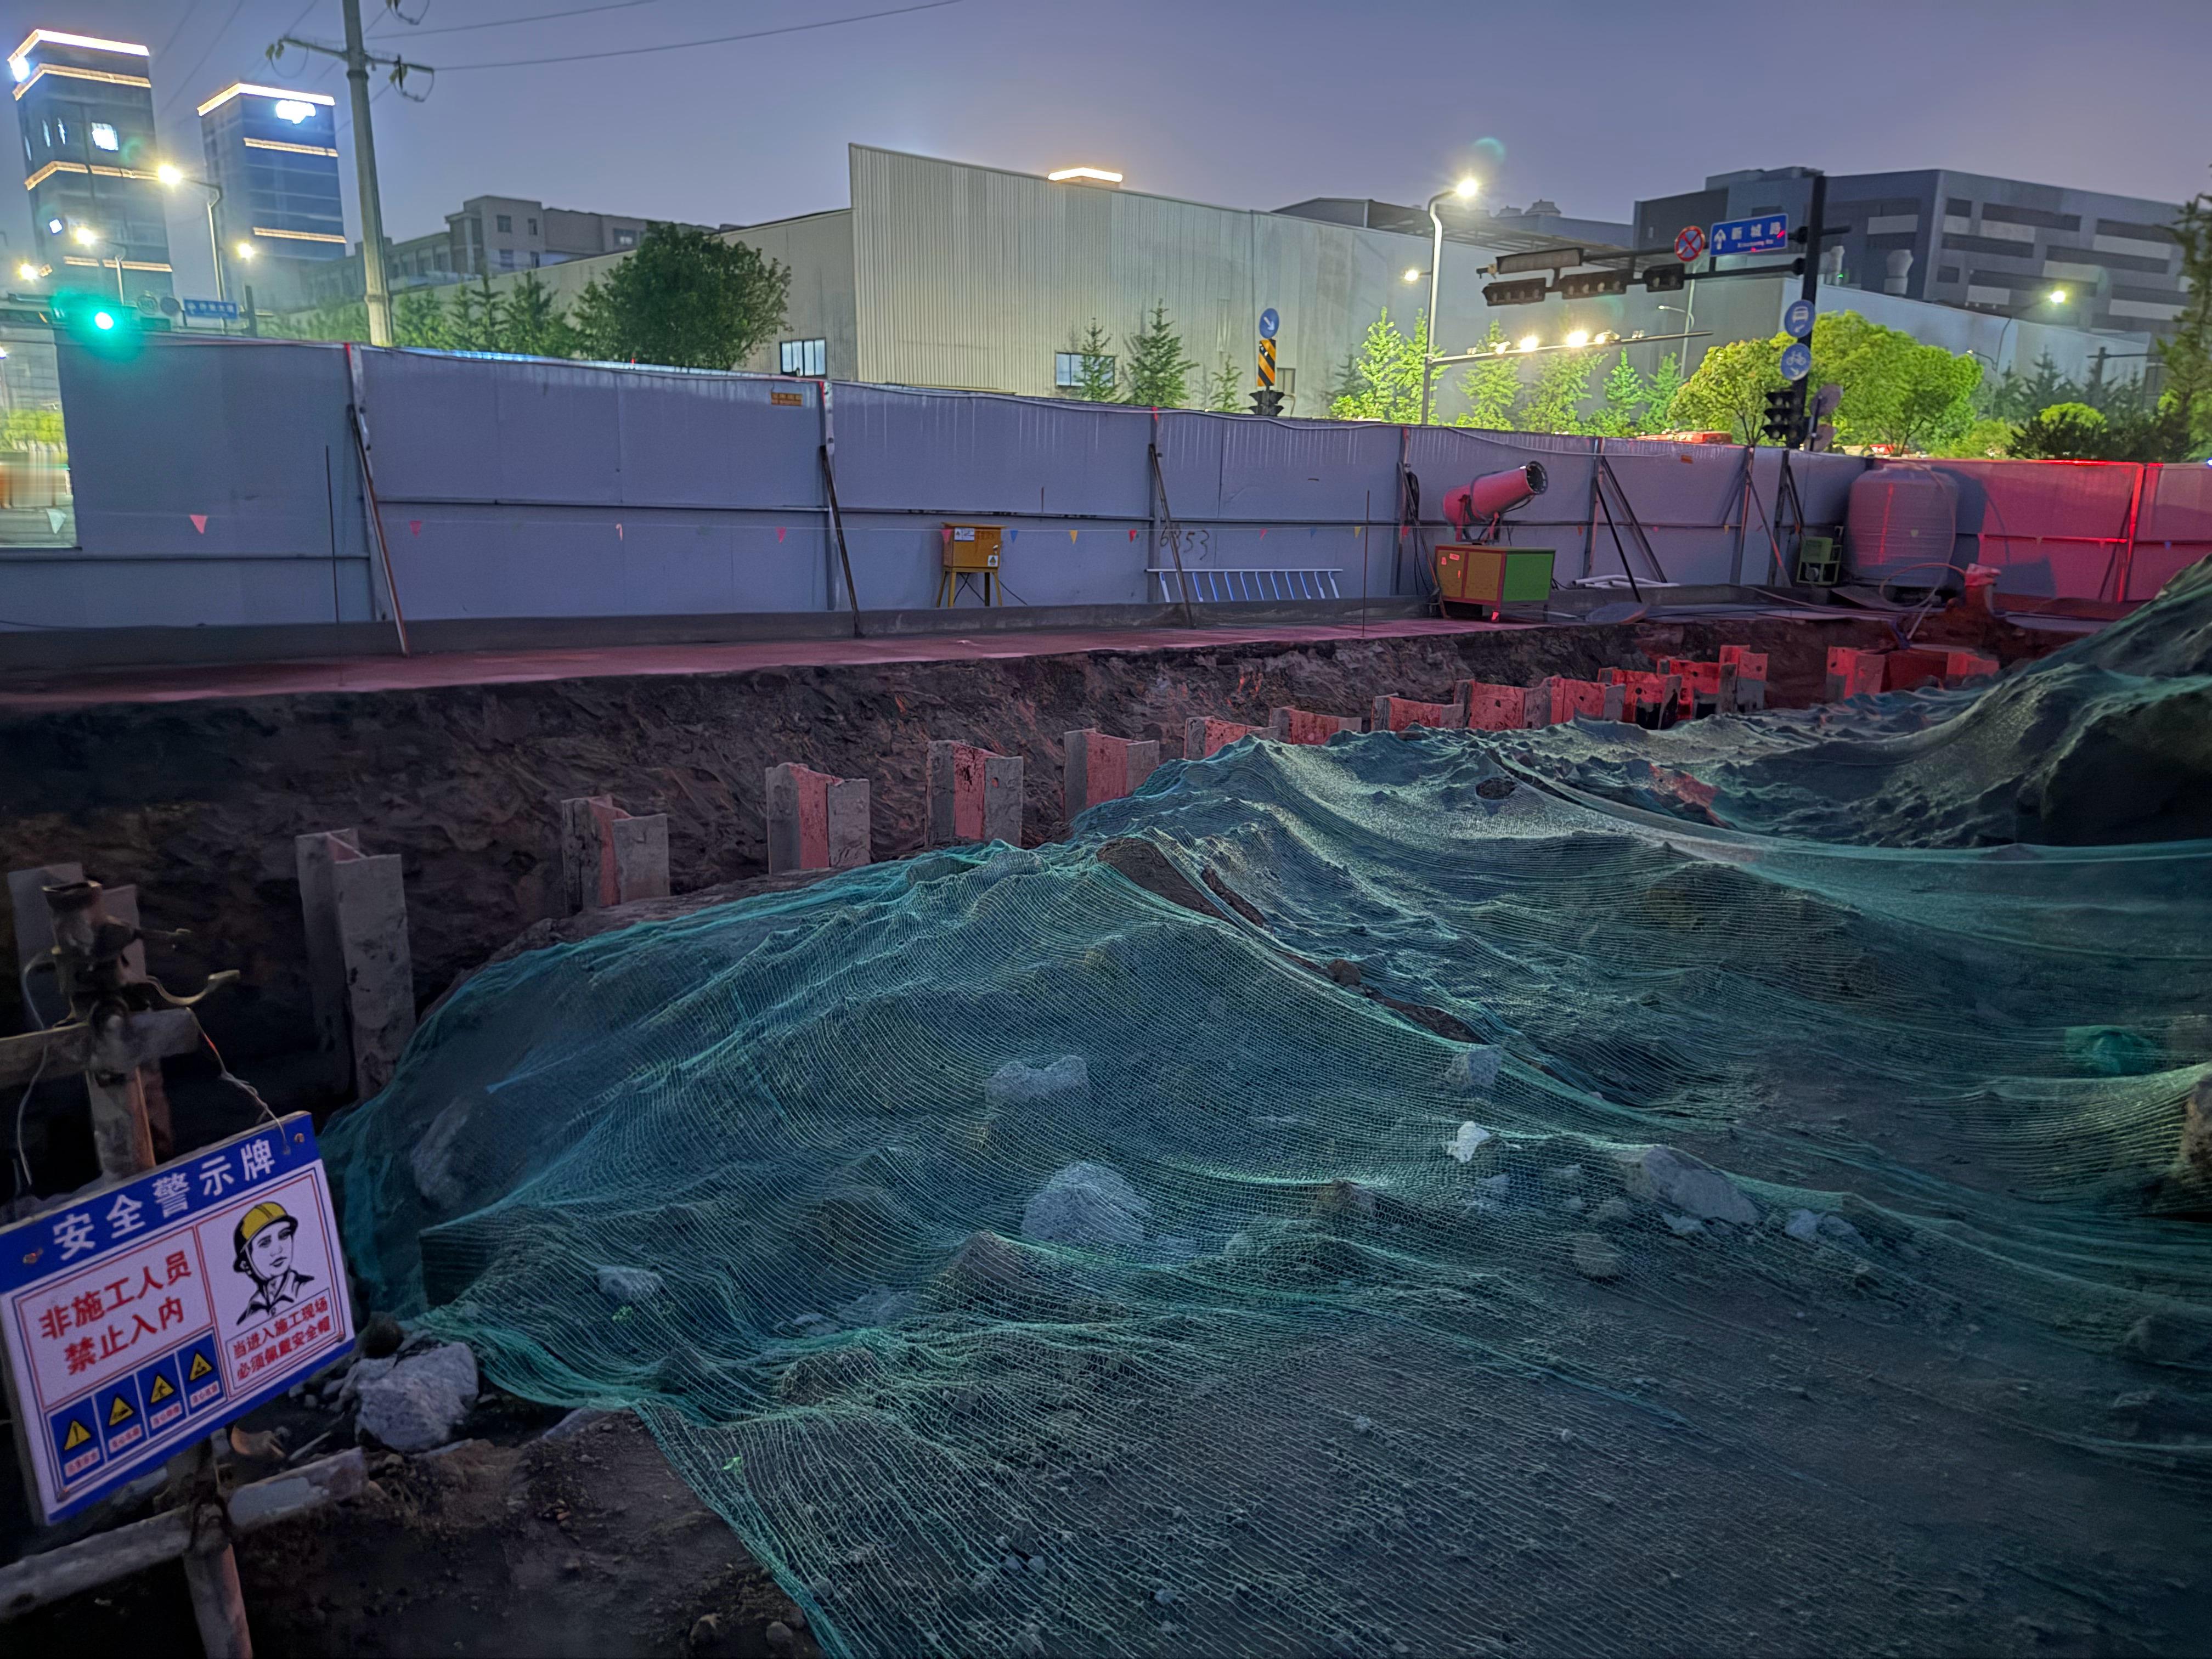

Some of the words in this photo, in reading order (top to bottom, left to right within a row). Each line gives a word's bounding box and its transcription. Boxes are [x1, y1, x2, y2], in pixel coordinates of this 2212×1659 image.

[53, 1139, 275, 1261] 安全警示牌
[38, 1250, 192, 1340] 非施工人员
[64, 1296, 184, 1375] 禁止入内
[233, 1296, 328, 1359] 当进入施工现场
